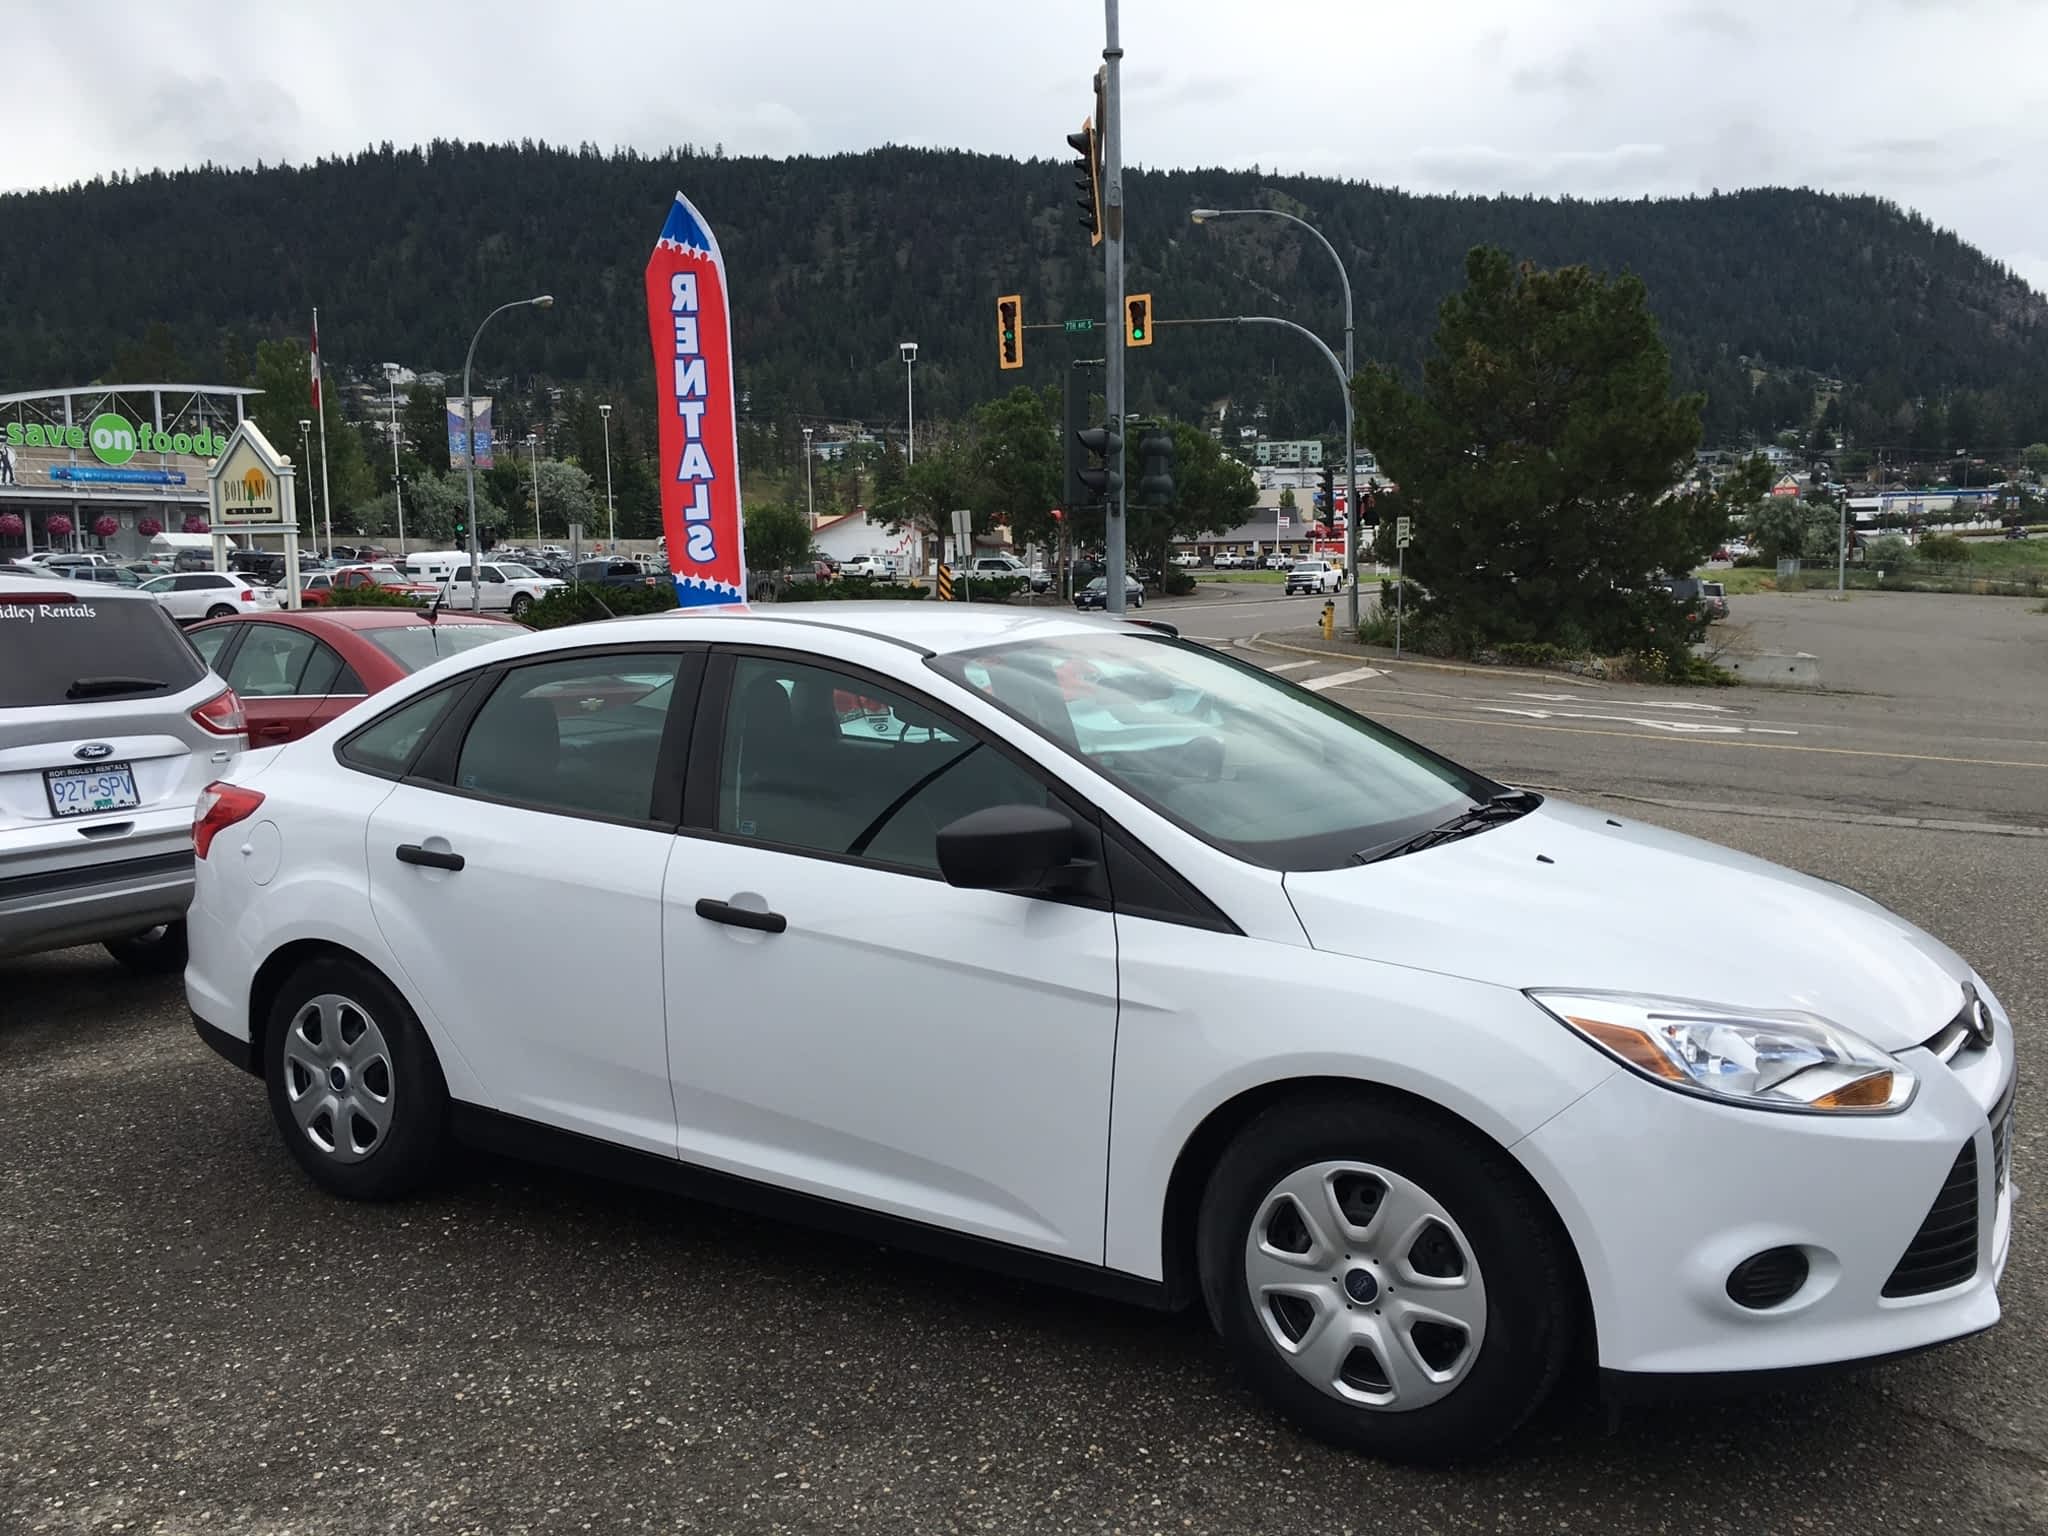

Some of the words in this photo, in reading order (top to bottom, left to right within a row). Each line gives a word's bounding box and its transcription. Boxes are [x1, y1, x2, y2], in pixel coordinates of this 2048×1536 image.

[6, 422, 85, 449] save
[93, 428, 132, 450] on
[138, 423, 229, 457] foods
[39, 604, 97, 618] Rentals
[54, 779, 86, 803] 927
[98, 775, 131, 797] SPV
